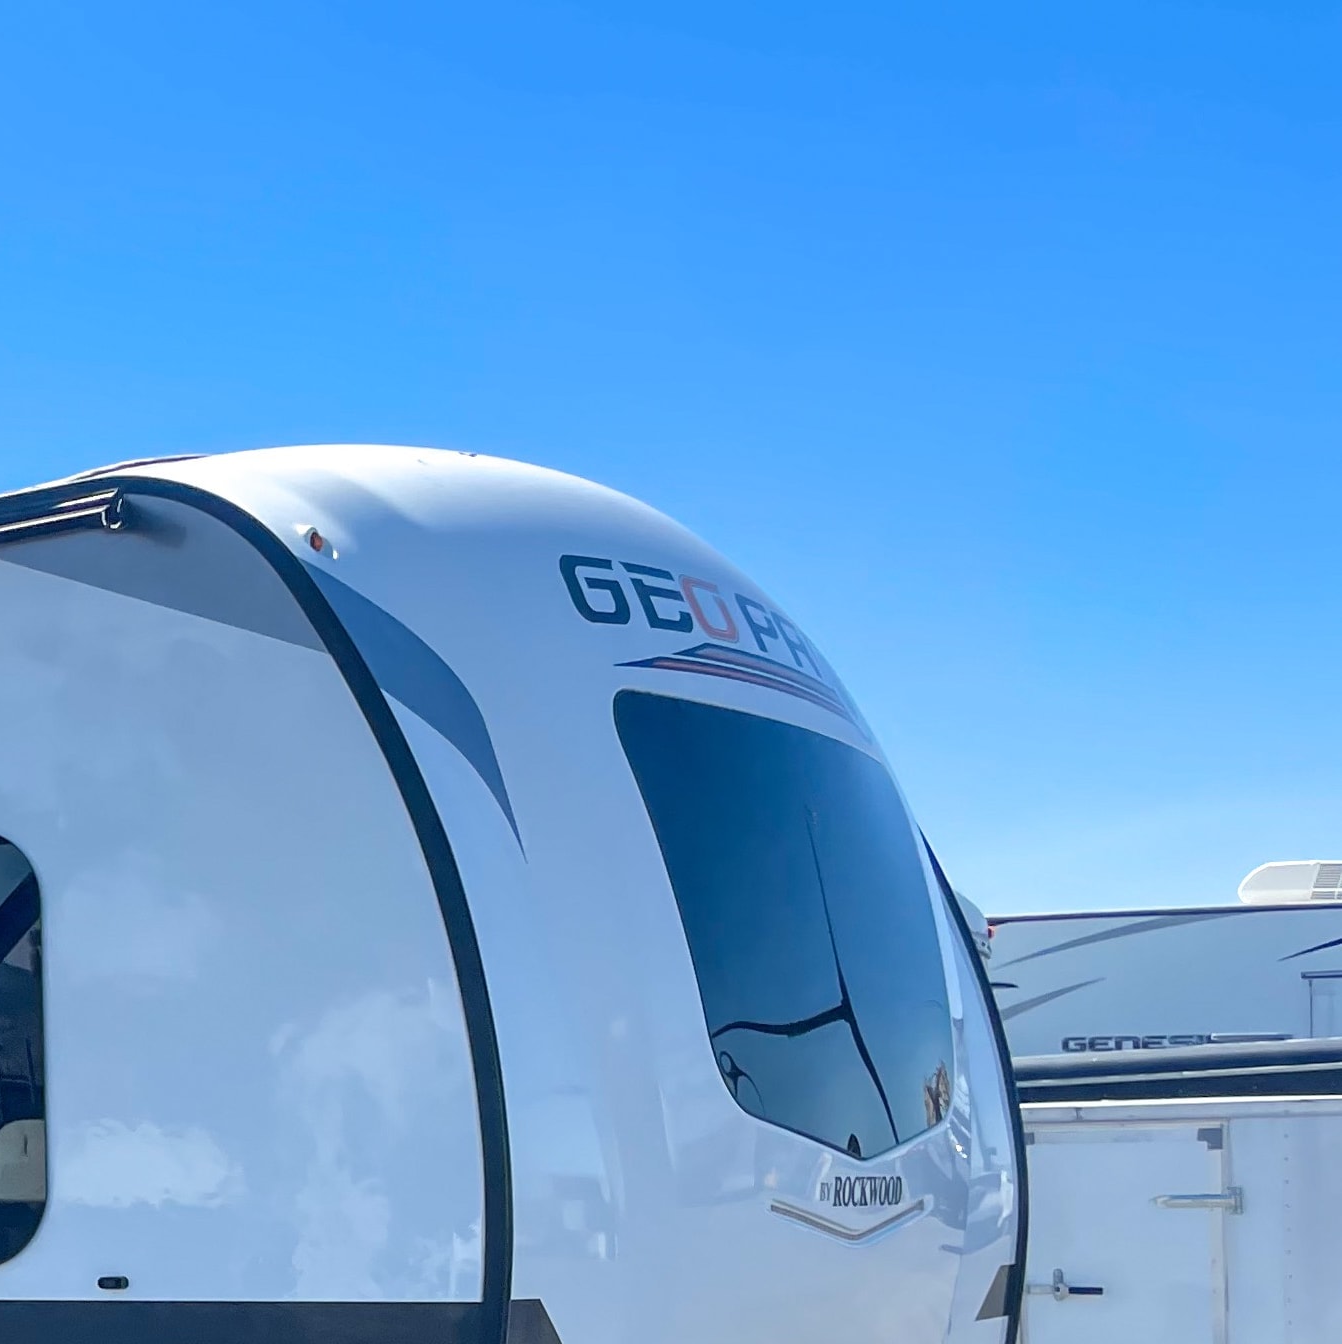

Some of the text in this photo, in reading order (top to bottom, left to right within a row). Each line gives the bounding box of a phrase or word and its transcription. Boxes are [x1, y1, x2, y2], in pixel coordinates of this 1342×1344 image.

[559, 554, 823, 678] GEO PR
[1062, 1033, 1213, 1053] GENESI
[820, 1175, 903, 1208] BY ROCKWOOD
